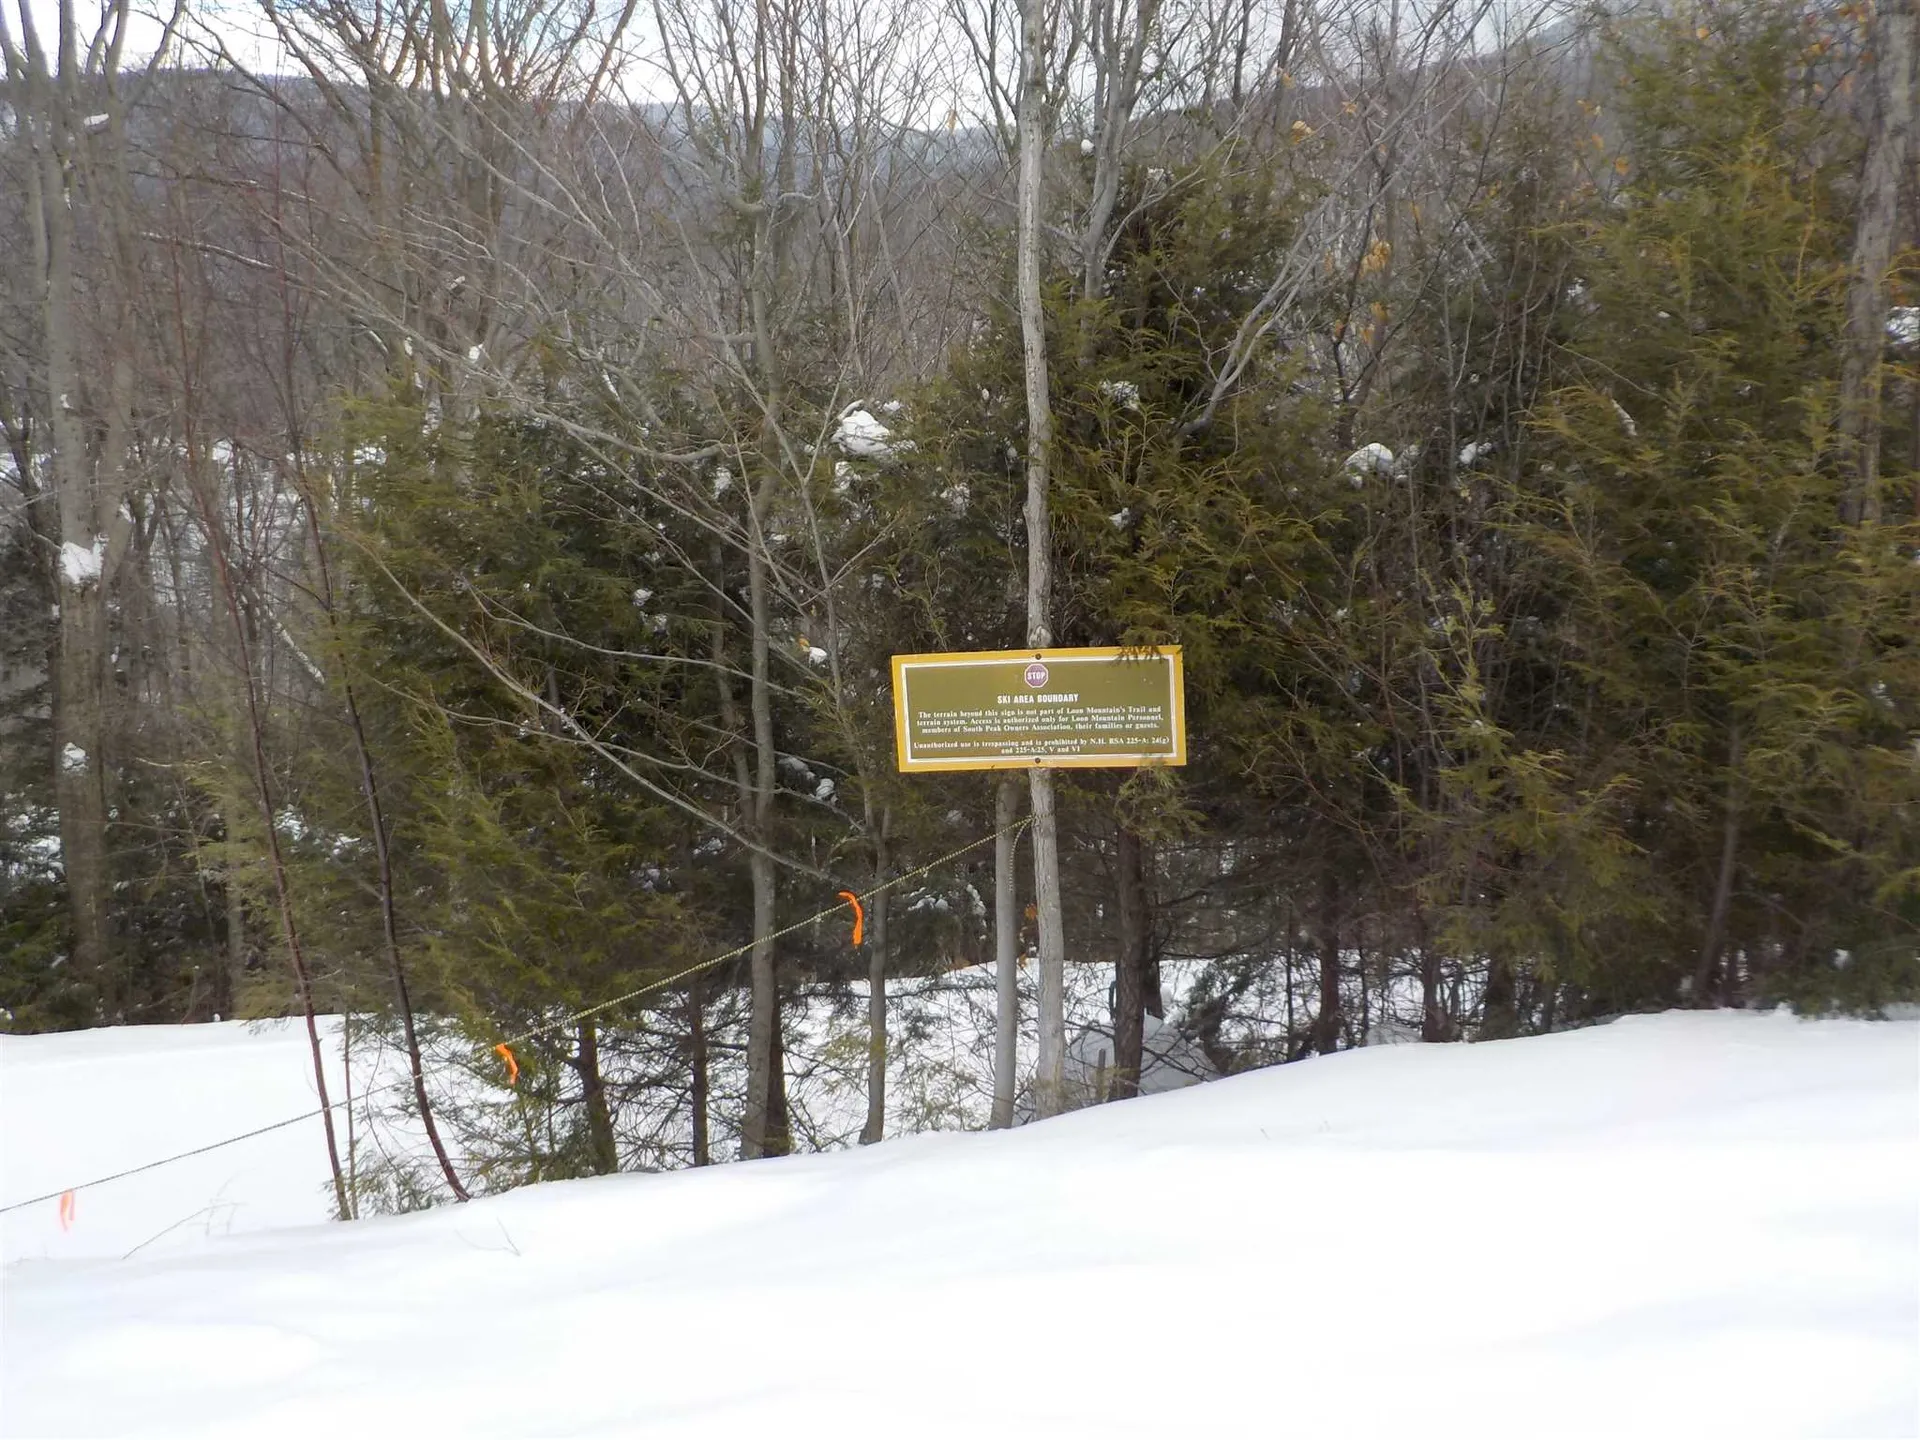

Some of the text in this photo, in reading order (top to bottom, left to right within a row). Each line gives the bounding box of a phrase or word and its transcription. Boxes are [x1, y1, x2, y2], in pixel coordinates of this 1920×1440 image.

[1027, 672, 1046, 680] STOP
[997, 694, 1078, 704] SKI AREA BOUNDARY
